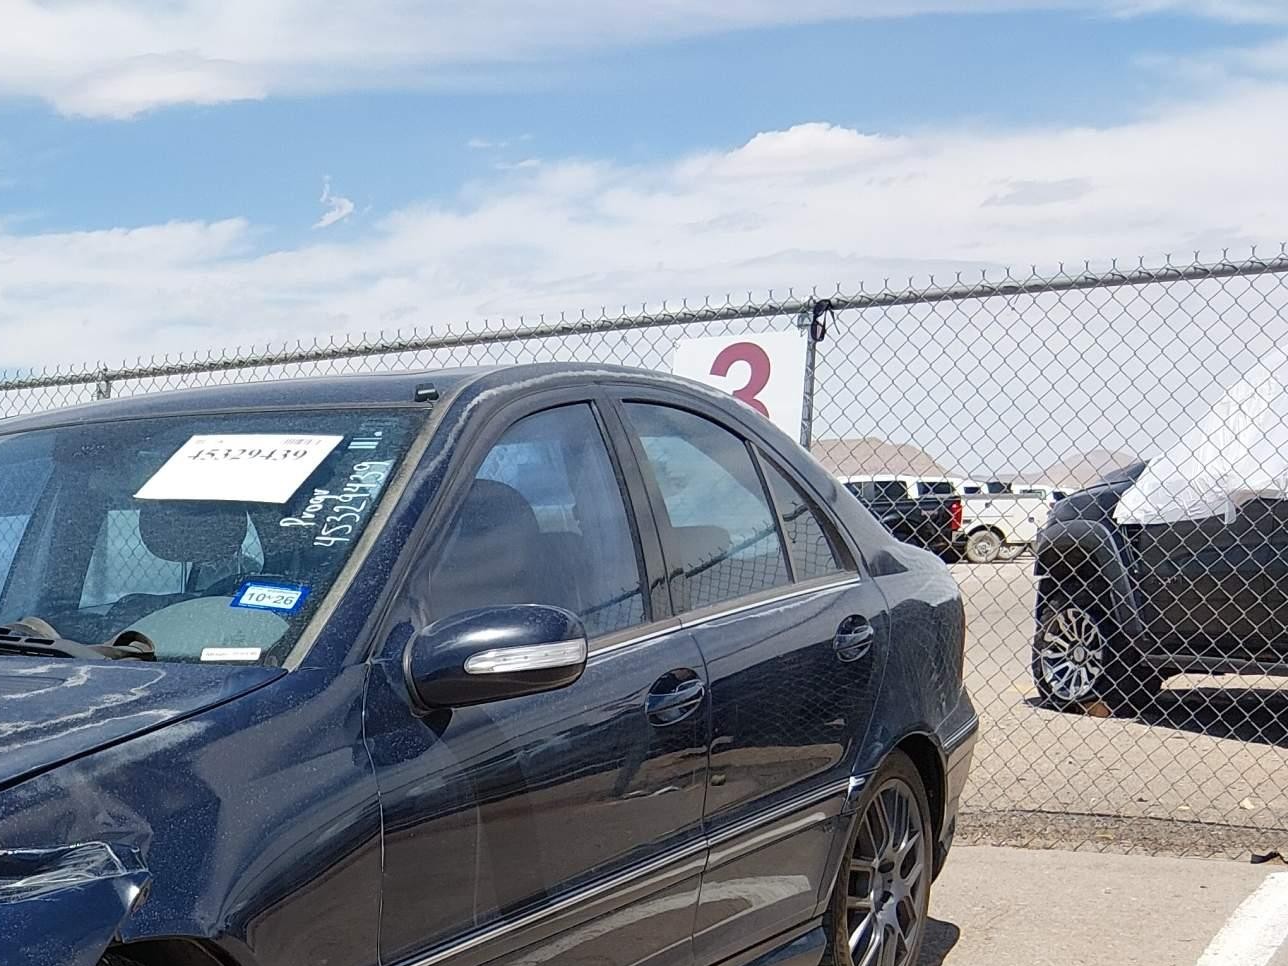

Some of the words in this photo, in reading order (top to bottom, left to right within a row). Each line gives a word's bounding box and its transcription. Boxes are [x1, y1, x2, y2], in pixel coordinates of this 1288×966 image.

[709, 341, 772, 420] 3
[187, 448, 308, 461] 45329439
[313, 461, 392, 546] 45329439
